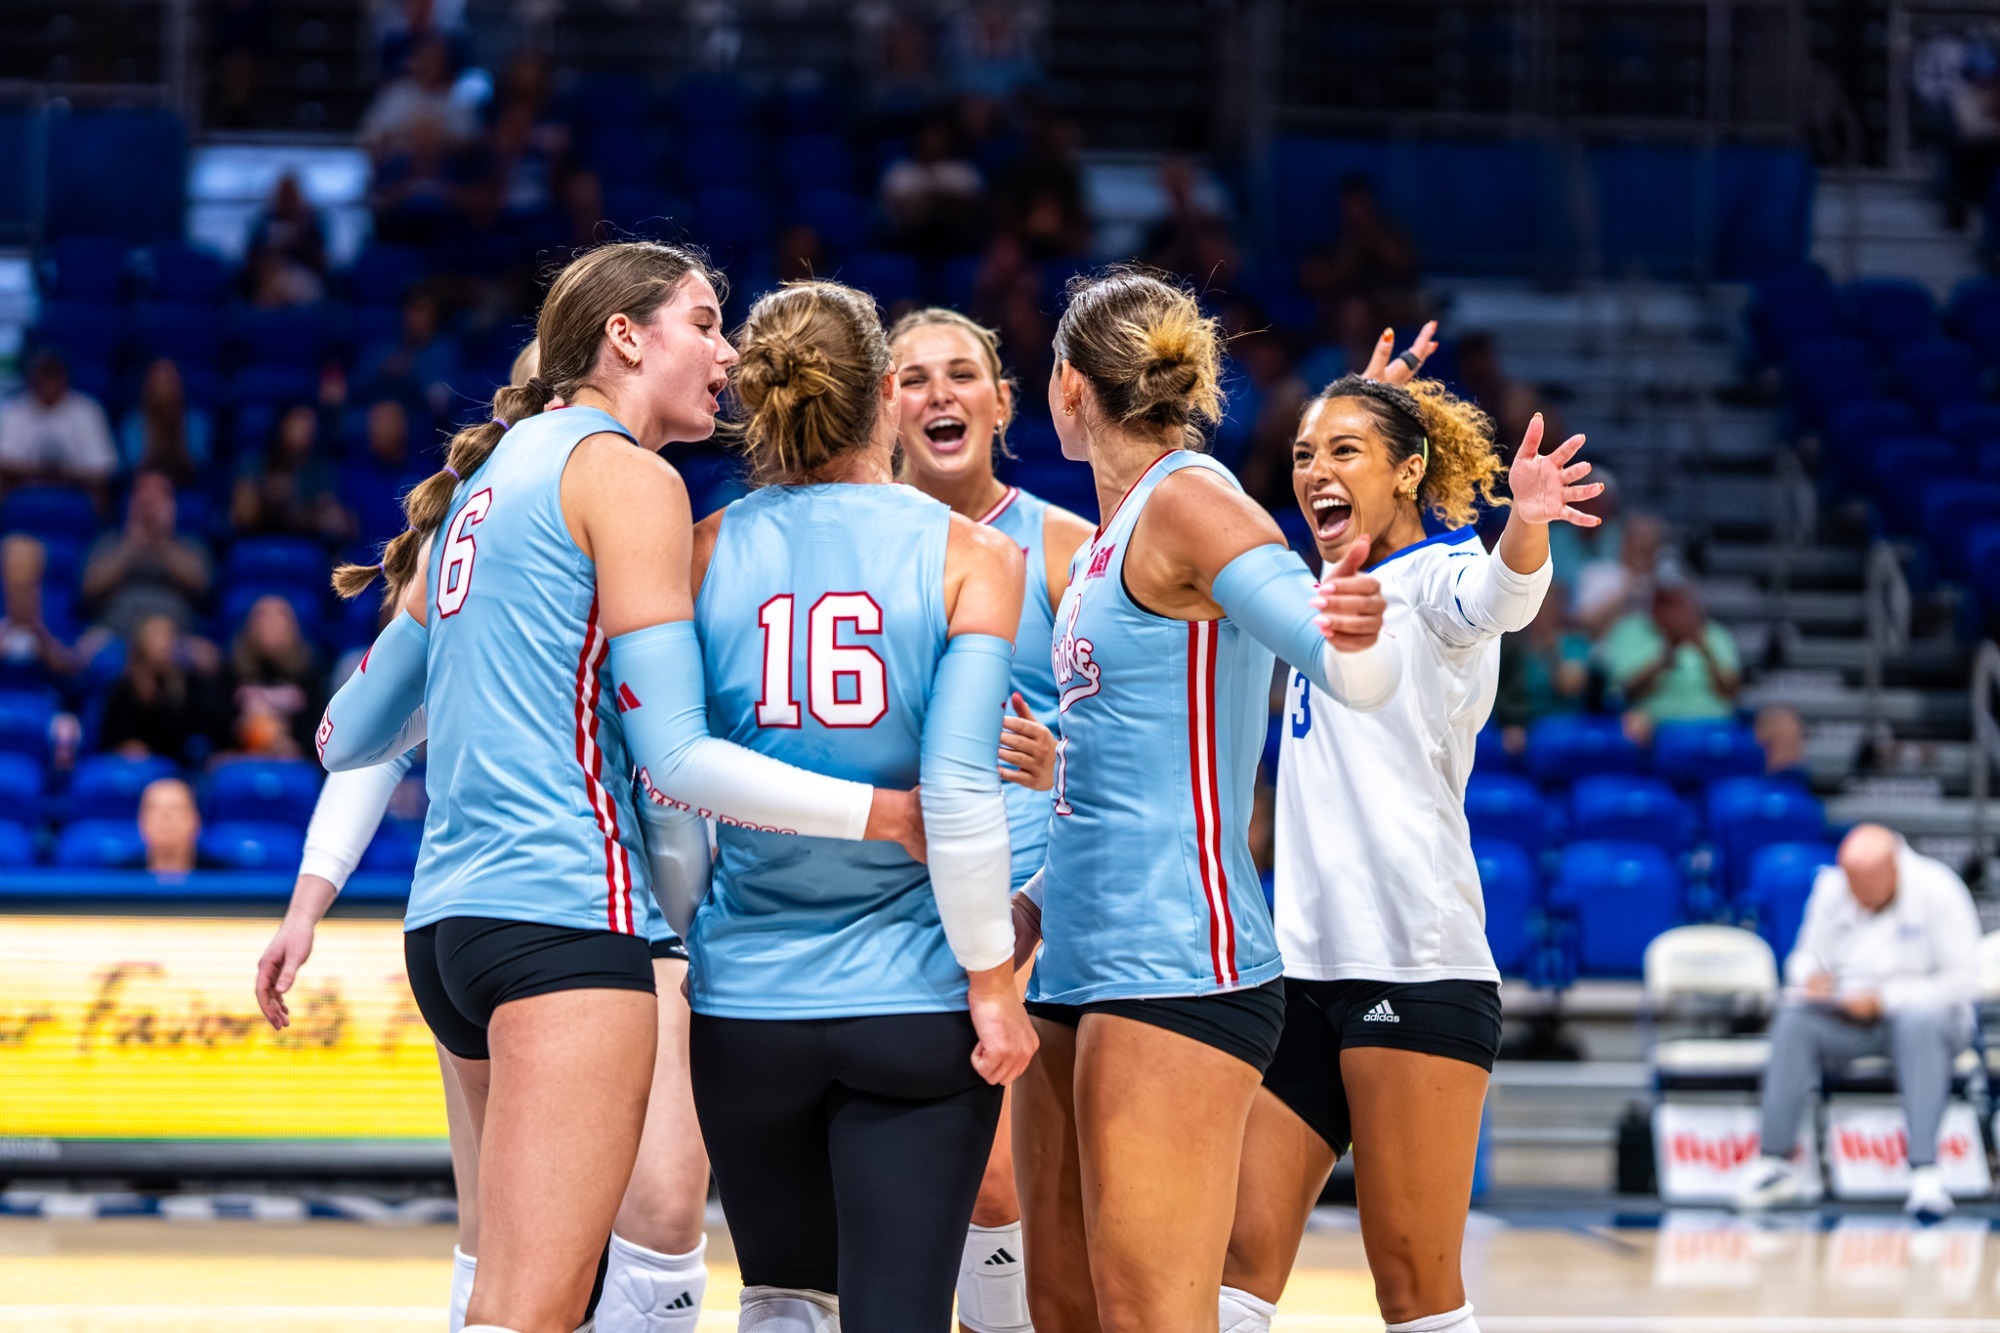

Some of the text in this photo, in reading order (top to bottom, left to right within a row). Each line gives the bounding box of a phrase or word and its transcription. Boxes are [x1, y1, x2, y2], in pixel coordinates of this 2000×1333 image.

[437, 487, 492, 619] 6
[755, 591, 888, 729] 16
[1292, 671, 1311, 739] 3
[1363, 1012, 1400, 1023] adidas
